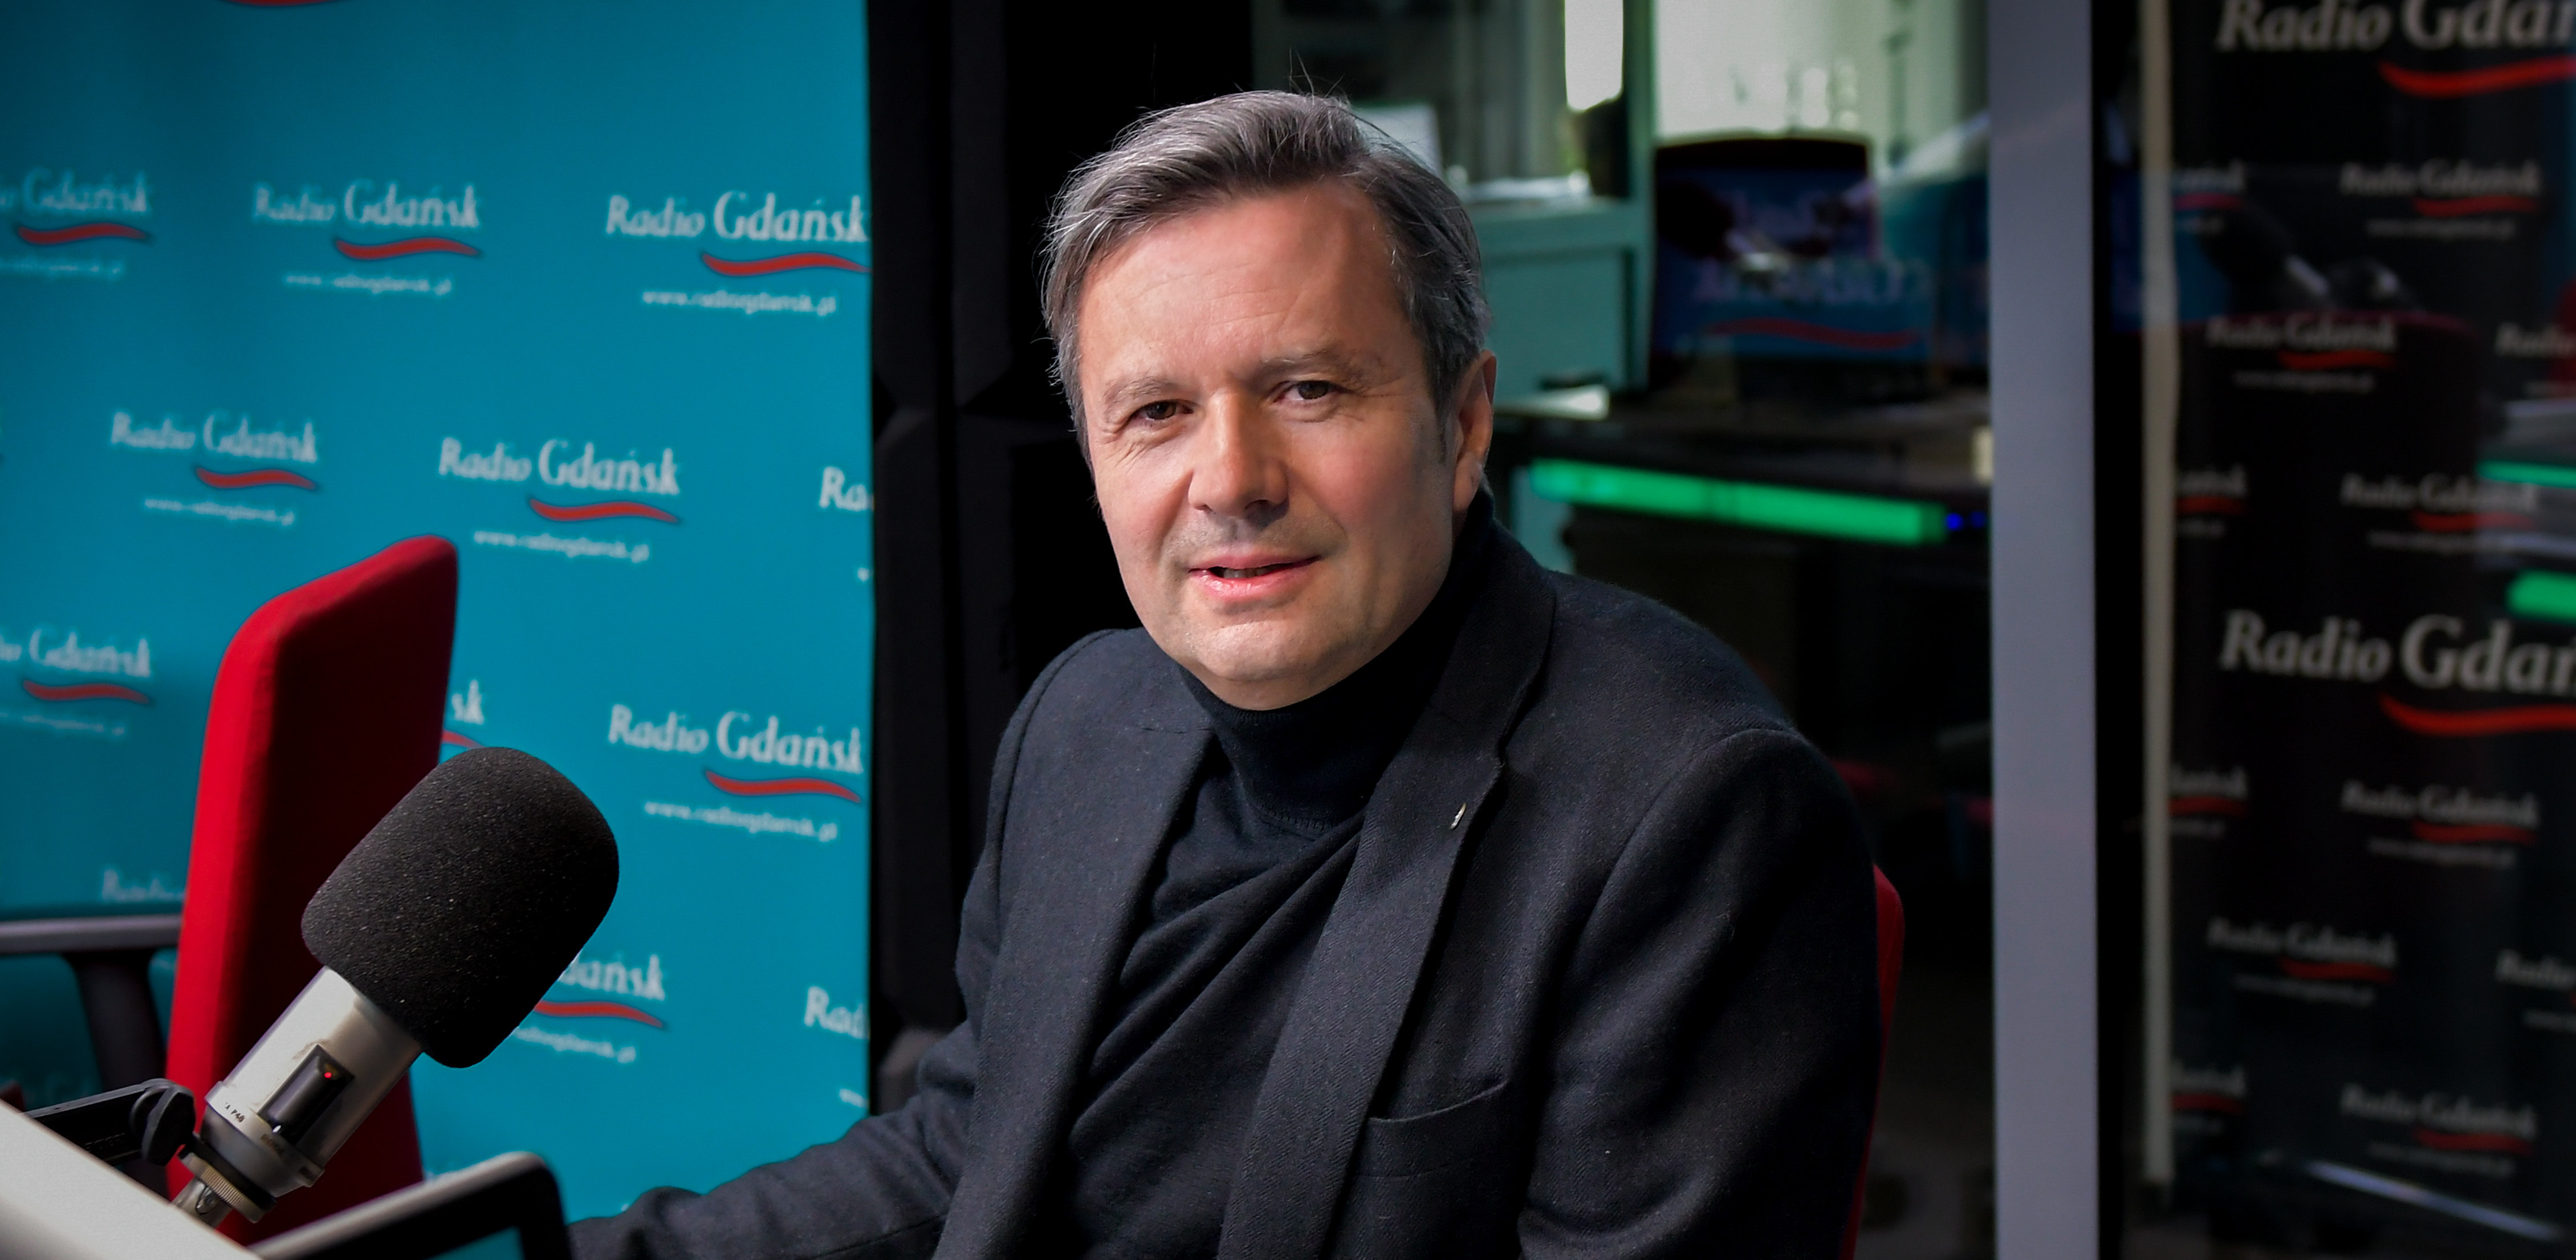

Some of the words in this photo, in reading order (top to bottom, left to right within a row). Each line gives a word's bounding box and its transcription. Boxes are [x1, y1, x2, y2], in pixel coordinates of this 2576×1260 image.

[2214, 0, 2394, 52] Radio
[2399, 0, 2576, 51] Gda
[606, 194, 705, 237] Radio
[713, 191, 868, 243] Gdańsk
[438, 437, 532, 481] Radio
[538, 438, 680, 495] Gdańsk
[2219, 607, 2394, 684] Radio
[2398, 613, 2576, 697] Gda
[608, 704, 709, 754] Radio
[715, 710, 864, 774] Gdańsk
